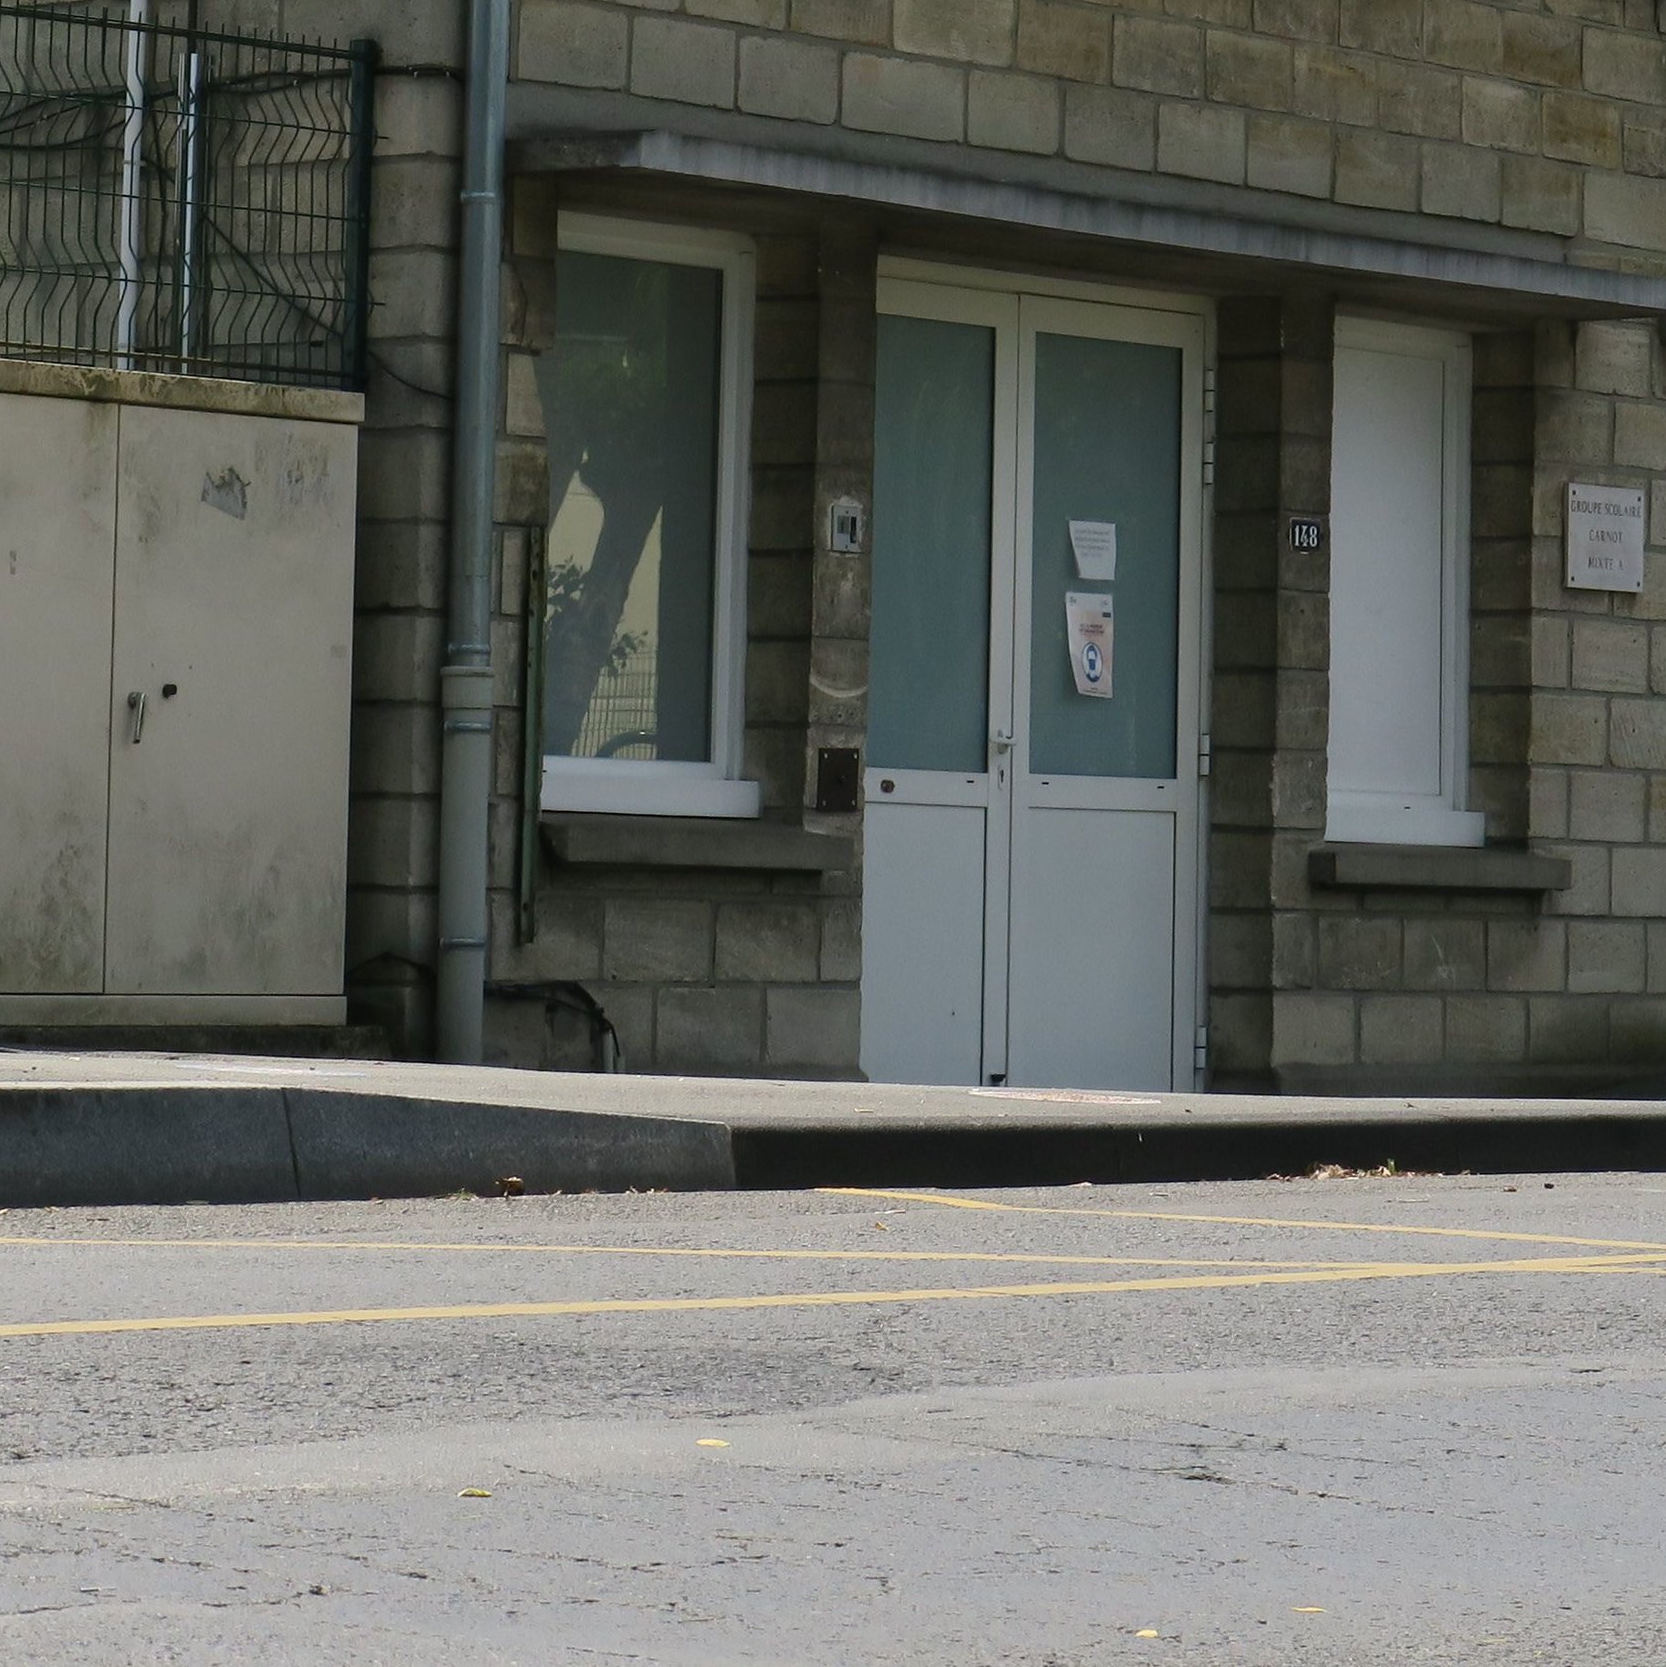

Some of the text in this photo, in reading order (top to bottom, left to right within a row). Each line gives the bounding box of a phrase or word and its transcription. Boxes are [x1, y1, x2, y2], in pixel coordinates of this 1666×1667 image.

[1571, 500, 1641, 518] GROUPE SCOLAIRE
[1294, 524, 1318, 547] 148
[1589, 529, 1623, 543] CARNOT
[1588, 556, 1613, 570] MIXTE
